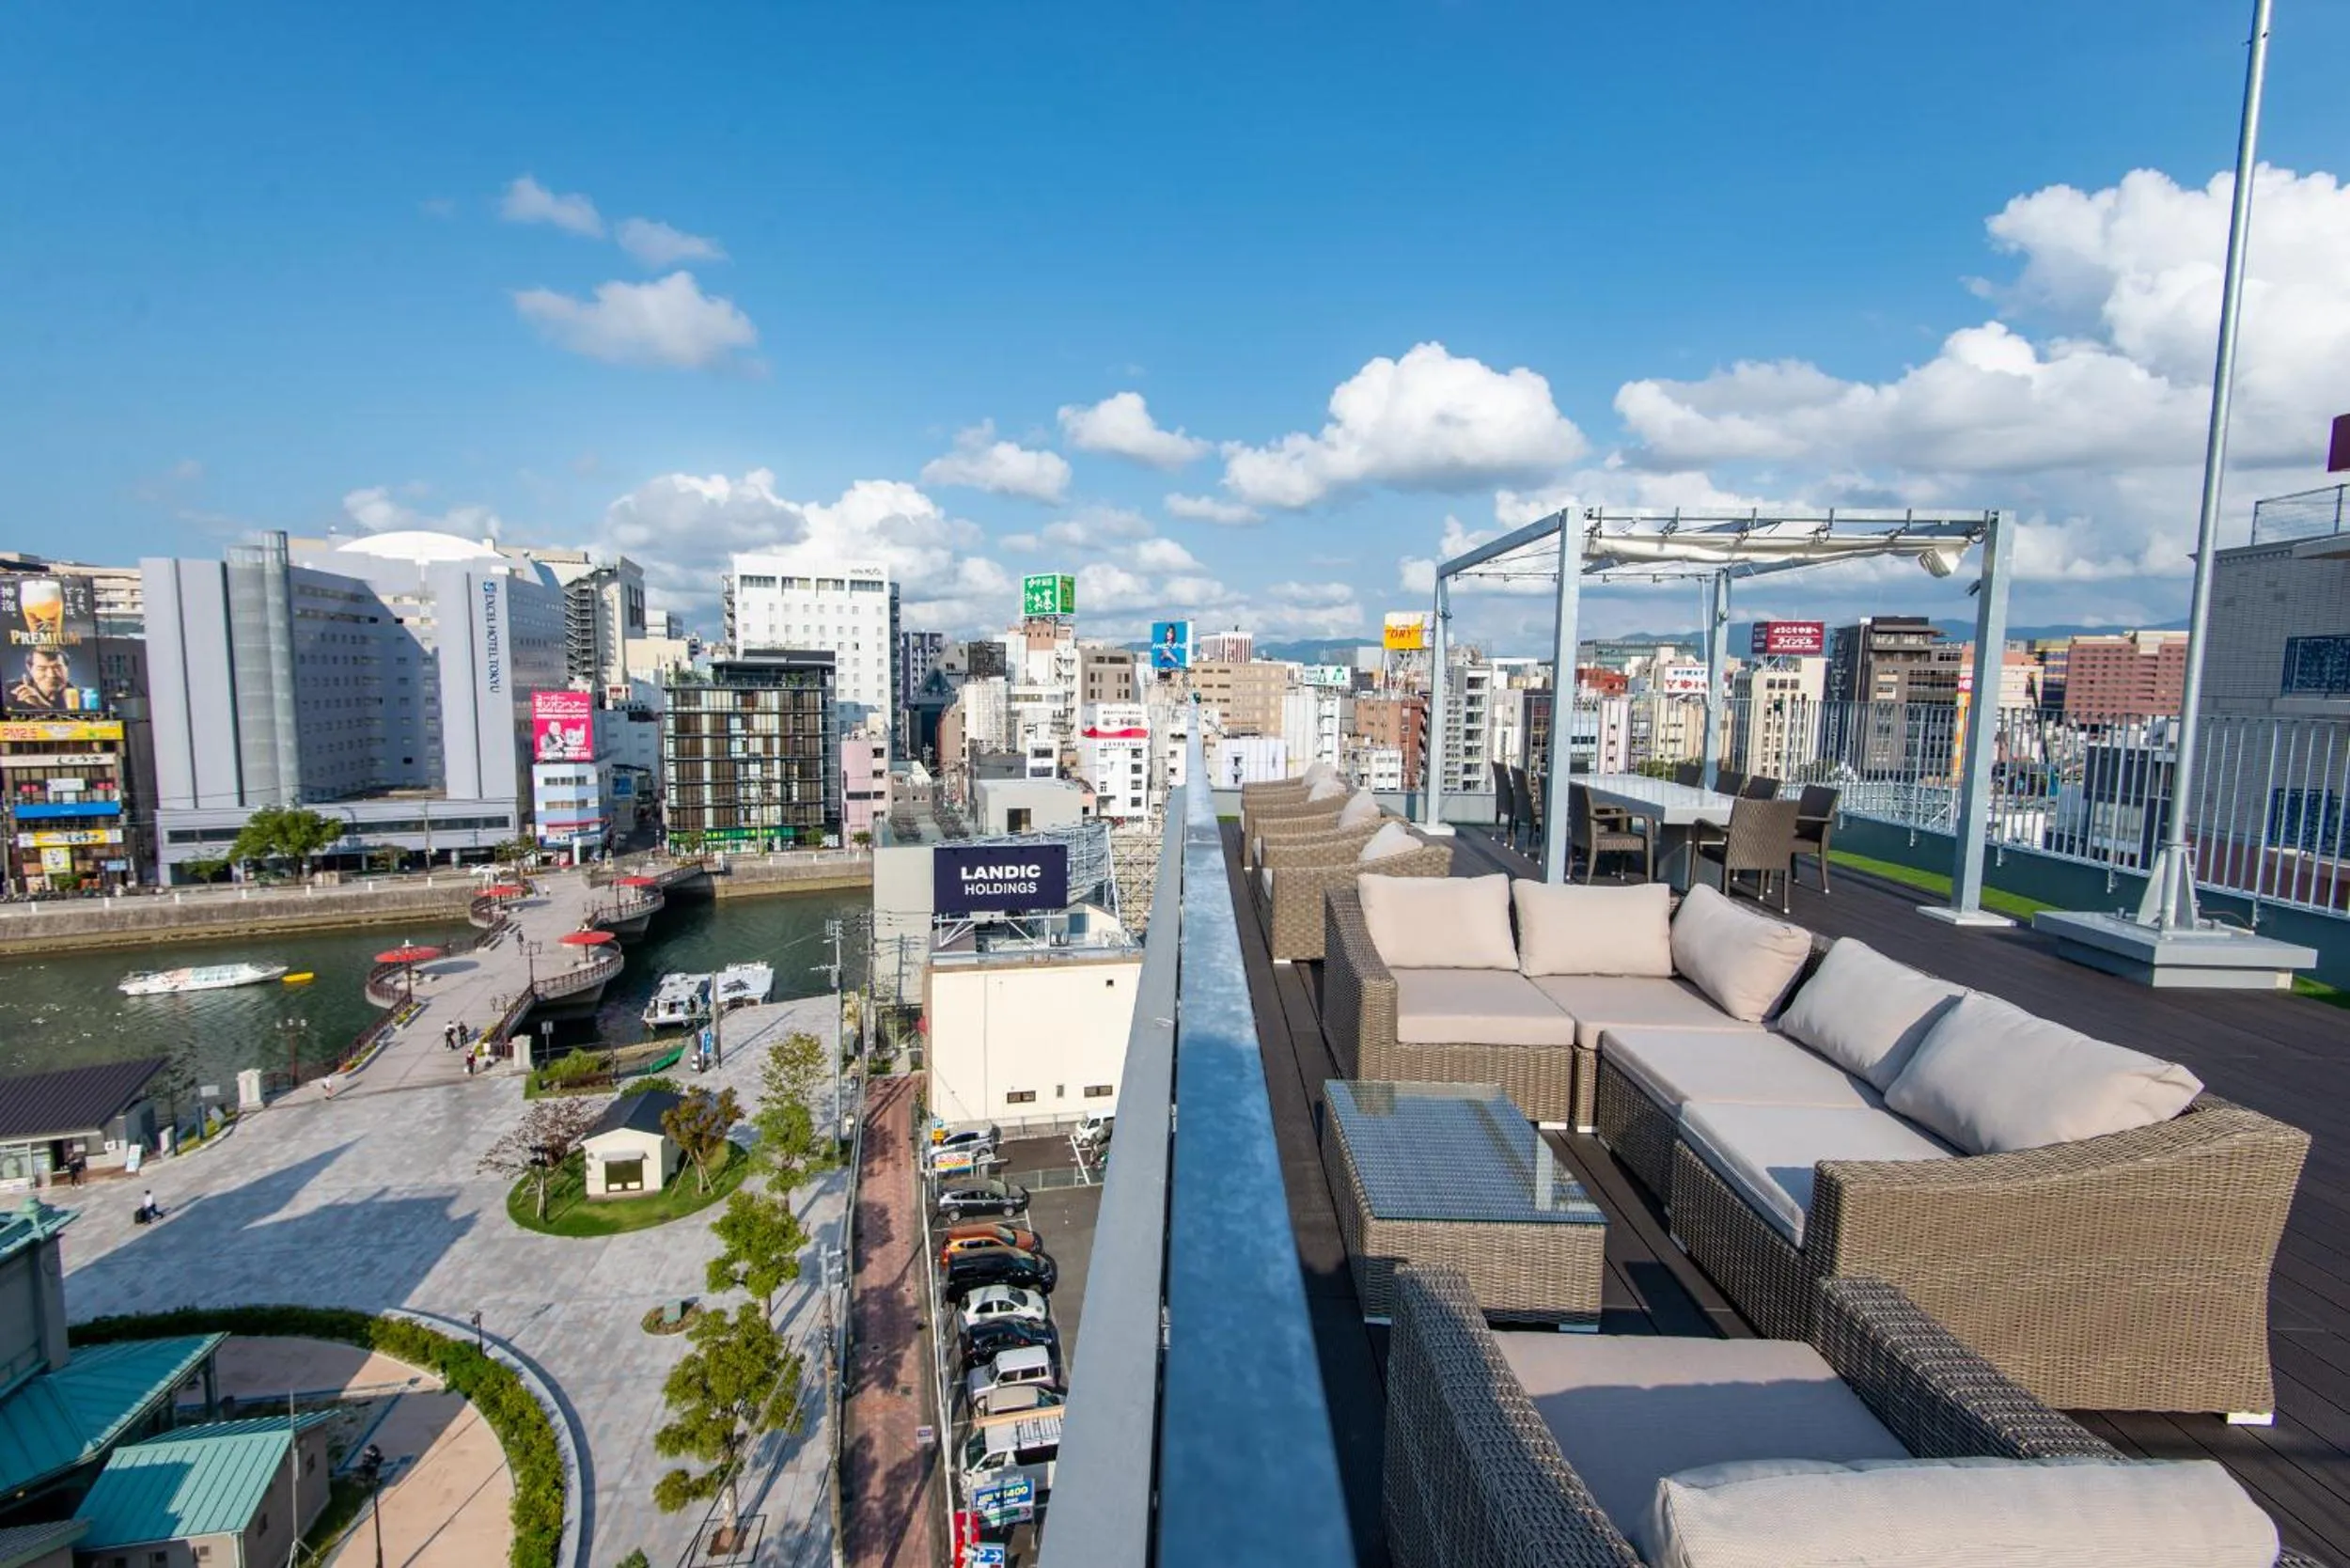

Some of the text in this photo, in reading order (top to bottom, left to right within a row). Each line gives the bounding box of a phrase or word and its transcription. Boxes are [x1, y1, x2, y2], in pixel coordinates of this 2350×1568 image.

[9, 629, 82, 646] PREMIUM
[485, 594, 501, 694] EXCEL HOTEL TOKYU
[961, 865, 1041, 880] LANDIC
[964, 882, 1038, 895] HOLDINGS
